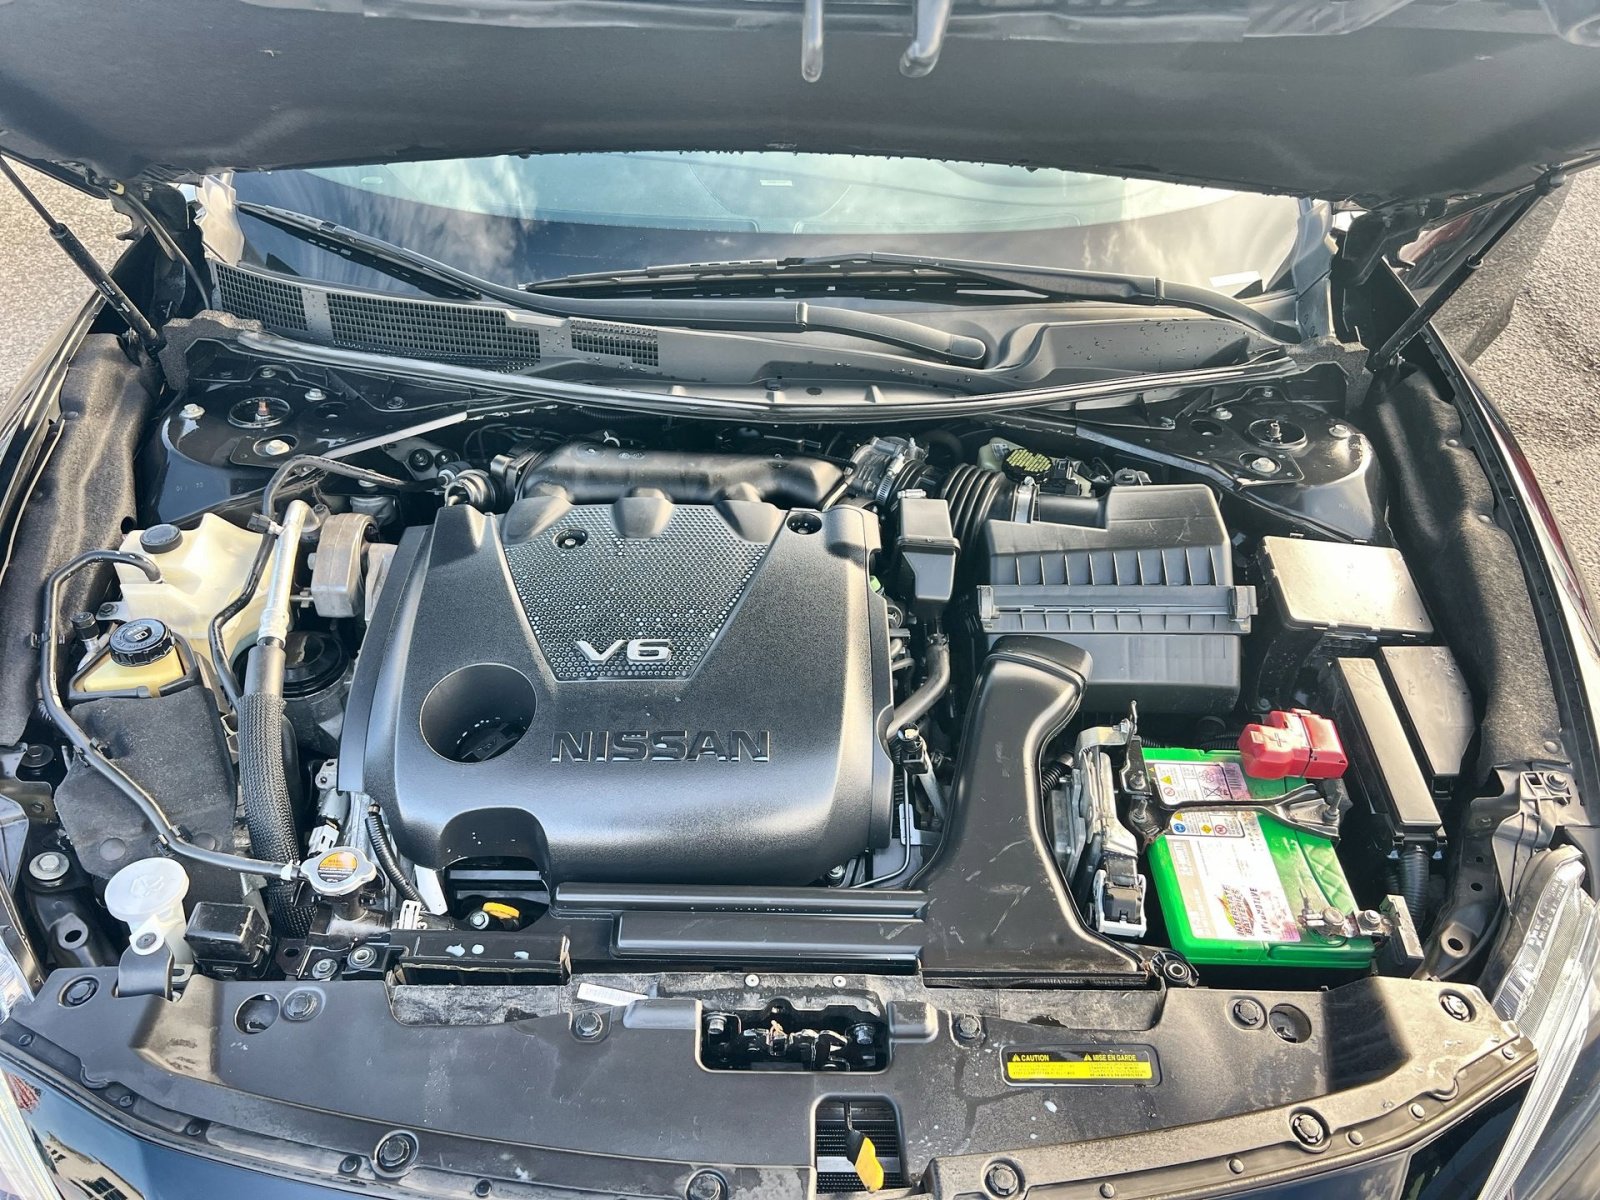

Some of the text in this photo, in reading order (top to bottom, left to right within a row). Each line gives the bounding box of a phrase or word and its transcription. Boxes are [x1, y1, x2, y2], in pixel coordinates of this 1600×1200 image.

[574, 638, 672, 664] V6
[551, 730, 770, 763] NISSAN
[1221, 884, 1245, 937] INTERSTATE
[1231, 888, 1255, 937] BATTERIES
[1020, 1054, 1050, 1062] CAUTION
[1092, 1054, 1137, 1062] MISE EN GARDE
